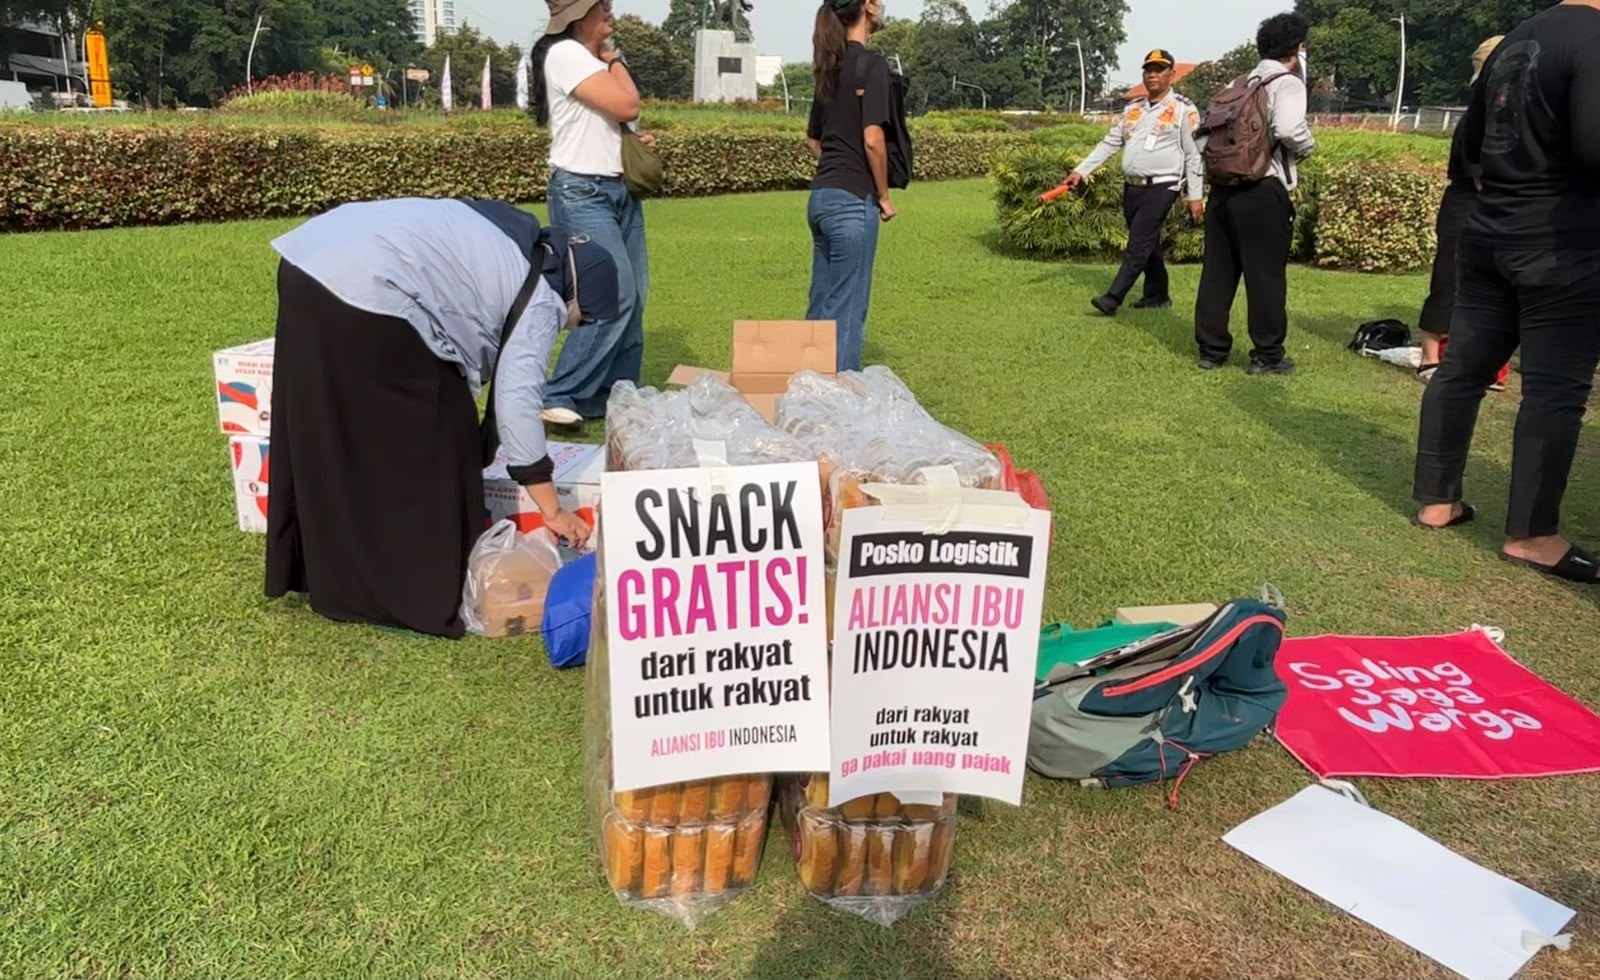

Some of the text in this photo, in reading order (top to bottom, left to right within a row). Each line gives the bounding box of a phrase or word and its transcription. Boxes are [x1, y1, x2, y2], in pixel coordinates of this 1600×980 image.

[635, 481, 802, 561] SNACK
[860, 539, 1020, 567] Posko Logistik
[617, 556, 809, 641] GRATIS!
[848, 583, 1025, 631] ALIANSI IBU
[641, 639, 793, 681] dari rakyat
[853, 628, 1009, 674] INDONESIA
[1288, 658, 1472, 690] Saling
[634, 675, 812, 718] untuk rakyat
[875, 706, 970, 725] dari rakyat
[1337, 703, 1542, 740] Warga
[651, 724, 797, 757] ALIANSI IBU INDONESIA
[870, 728, 978, 747] untuk rakyat
[841, 749, 1011, 777] ga pakai uang pajak
